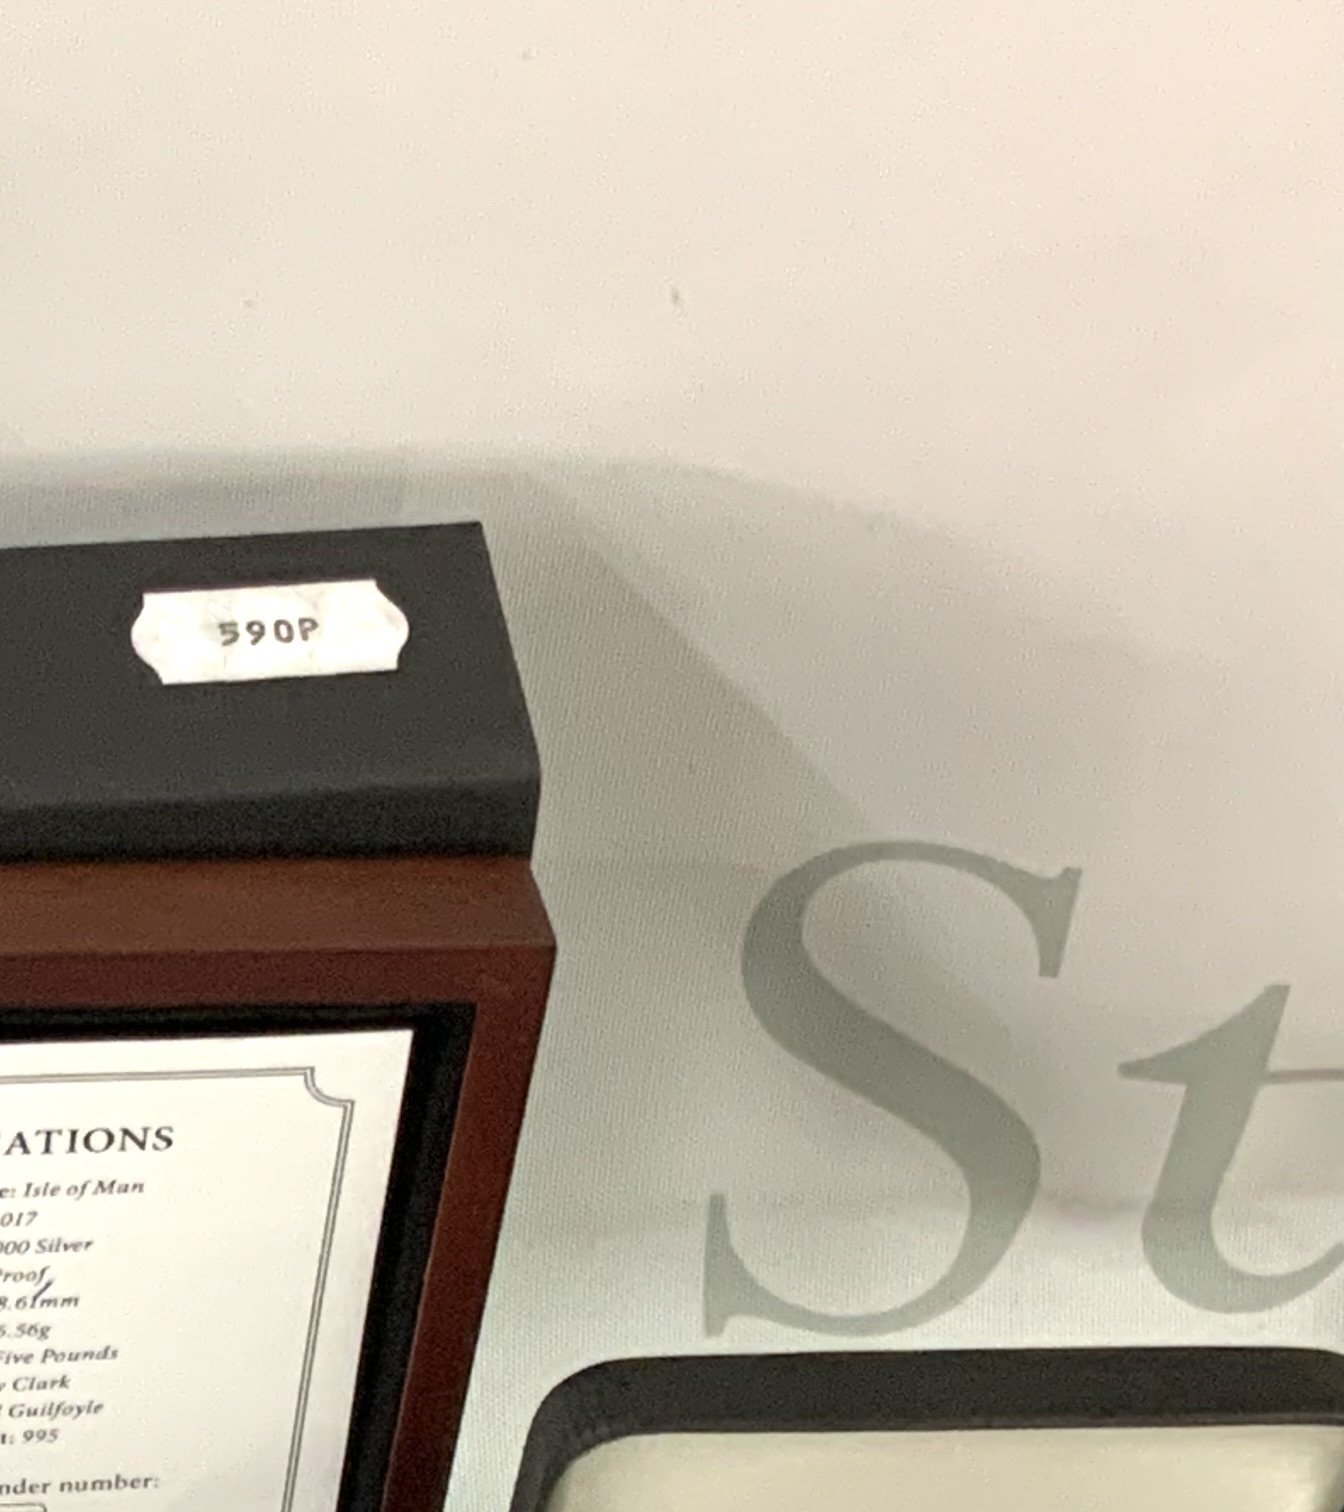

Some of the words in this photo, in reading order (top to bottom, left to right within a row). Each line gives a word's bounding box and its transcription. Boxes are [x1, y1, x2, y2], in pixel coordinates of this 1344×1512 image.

[218, 618, 319, 646] 590P
[22, 1181, 62, 1198] Isle
[65, 1180, 91, 1199] of
[92, 1178, 145, 1196] Man
[35, 1237, 93, 1255] Silver
[40, 1345, 119, 1364] Pounds
[12, 1375, 71, 1392] Clark
[8, 1400, 104, 1419] Guilfoyle
[22, 1429, 60, 1444] 995
[59, 1474, 161, 1494] number:
